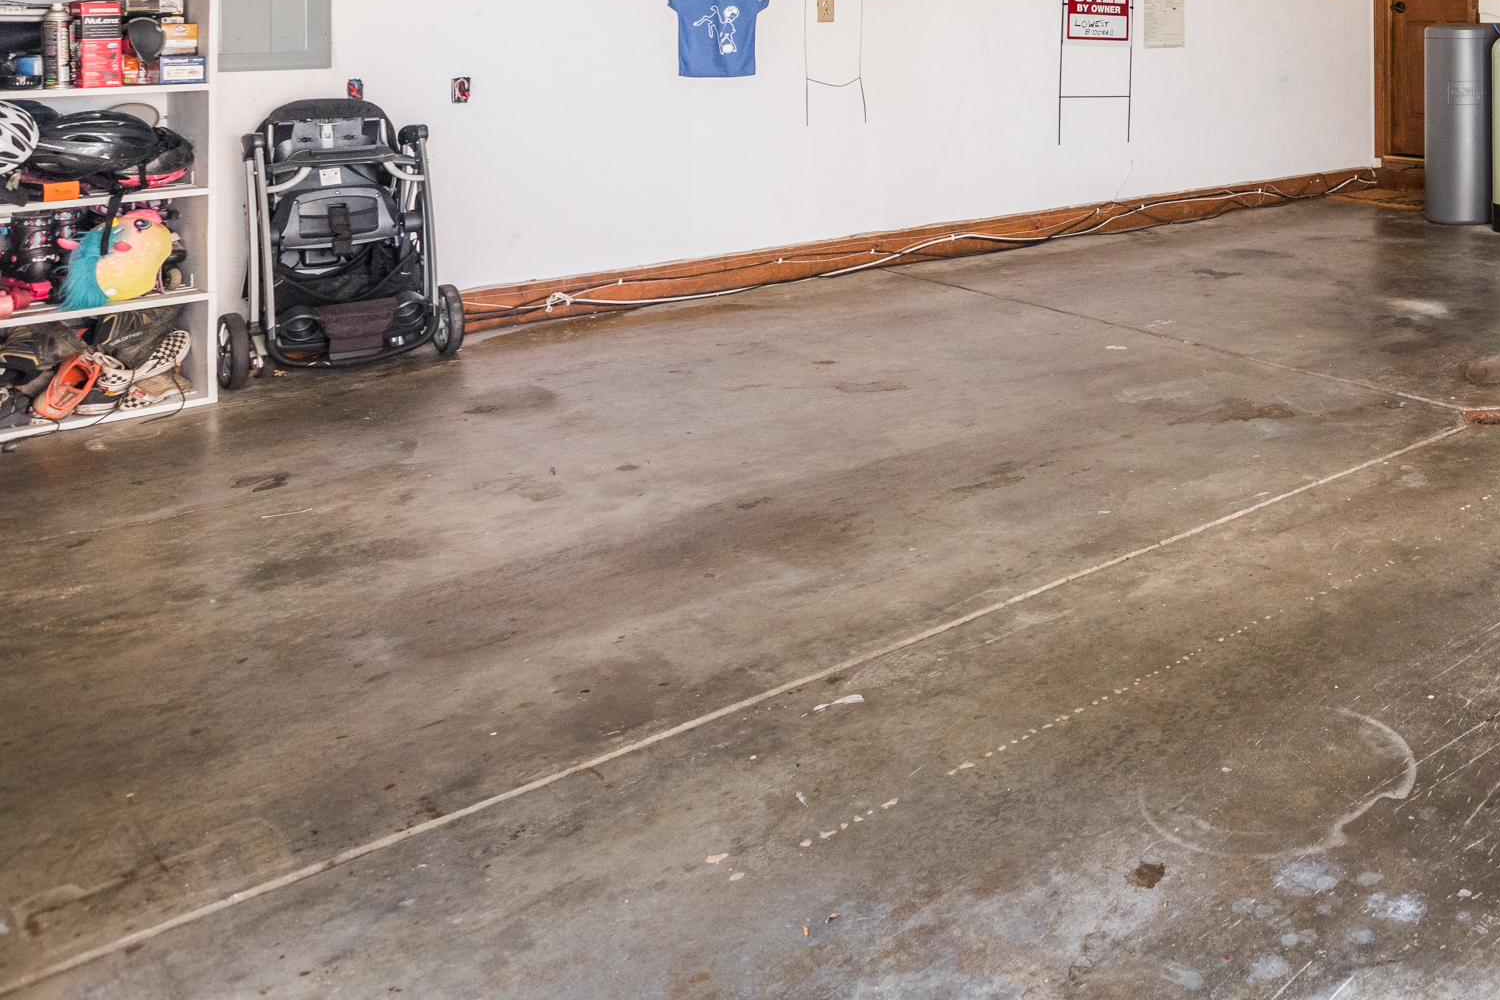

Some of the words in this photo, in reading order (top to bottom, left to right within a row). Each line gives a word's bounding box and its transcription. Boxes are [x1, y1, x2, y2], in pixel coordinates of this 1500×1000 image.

[1076, 4, 1089, 12] BY
[1091, 4, 1121, 14] OWNER
[1074, 19, 1109, 28] LOWEST
